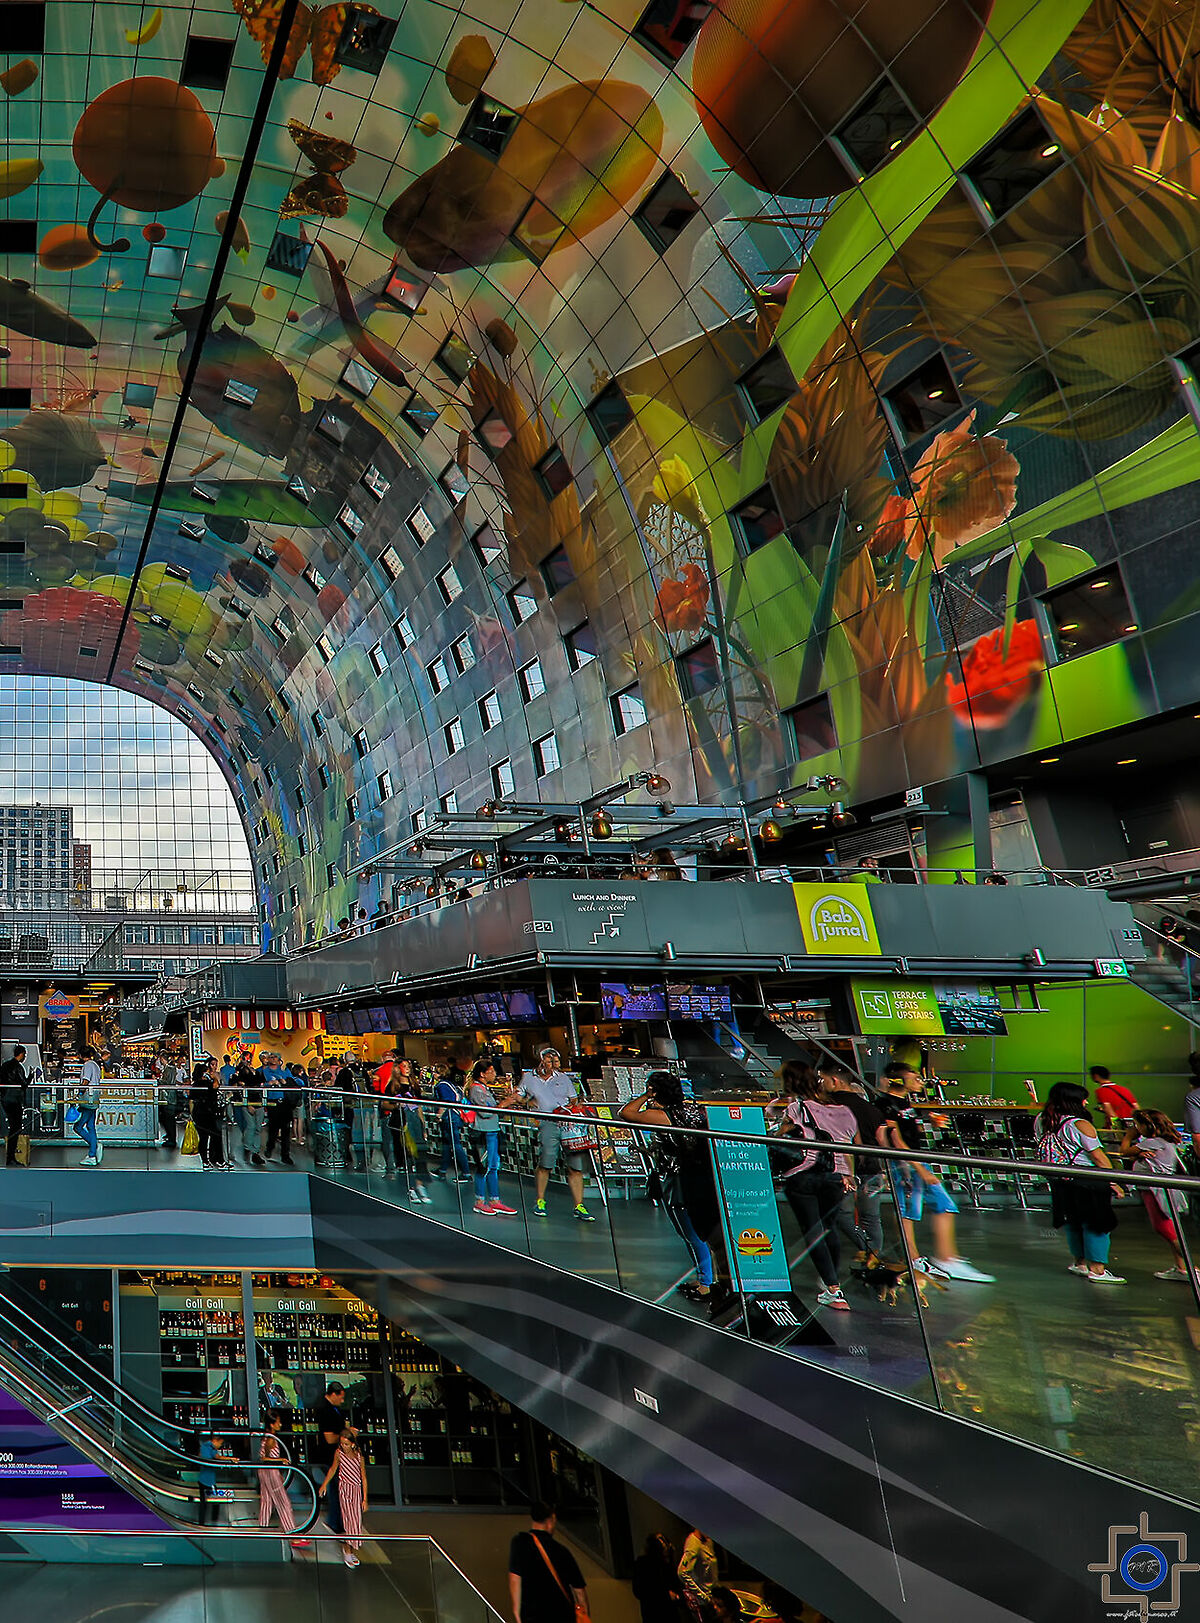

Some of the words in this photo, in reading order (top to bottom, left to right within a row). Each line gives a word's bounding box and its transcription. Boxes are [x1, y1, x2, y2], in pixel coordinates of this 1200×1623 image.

[821, 904, 853, 923] Bab
[818, 923, 861, 941] Tuma
[892, 990, 927, 1000] TERRACE
[894, 1000, 919, 1010] SEATS
[897, 1010, 935, 1020] UPSTAIRS
[96, 1112, 137, 1126] ATAT
[728, 1150, 736, 1159] in
[738, 1150, 749, 1159] de
[719, 1162, 766, 1171] MARKTHAL
[185, 1298, 203, 1309] Gall
[206, 1298, 224, 1309] Gall
[277, 1300, 295, 1311] Gall
[299, 1300, 316, 1311] Gall
[347, 1301, 365, 1312] Gall
